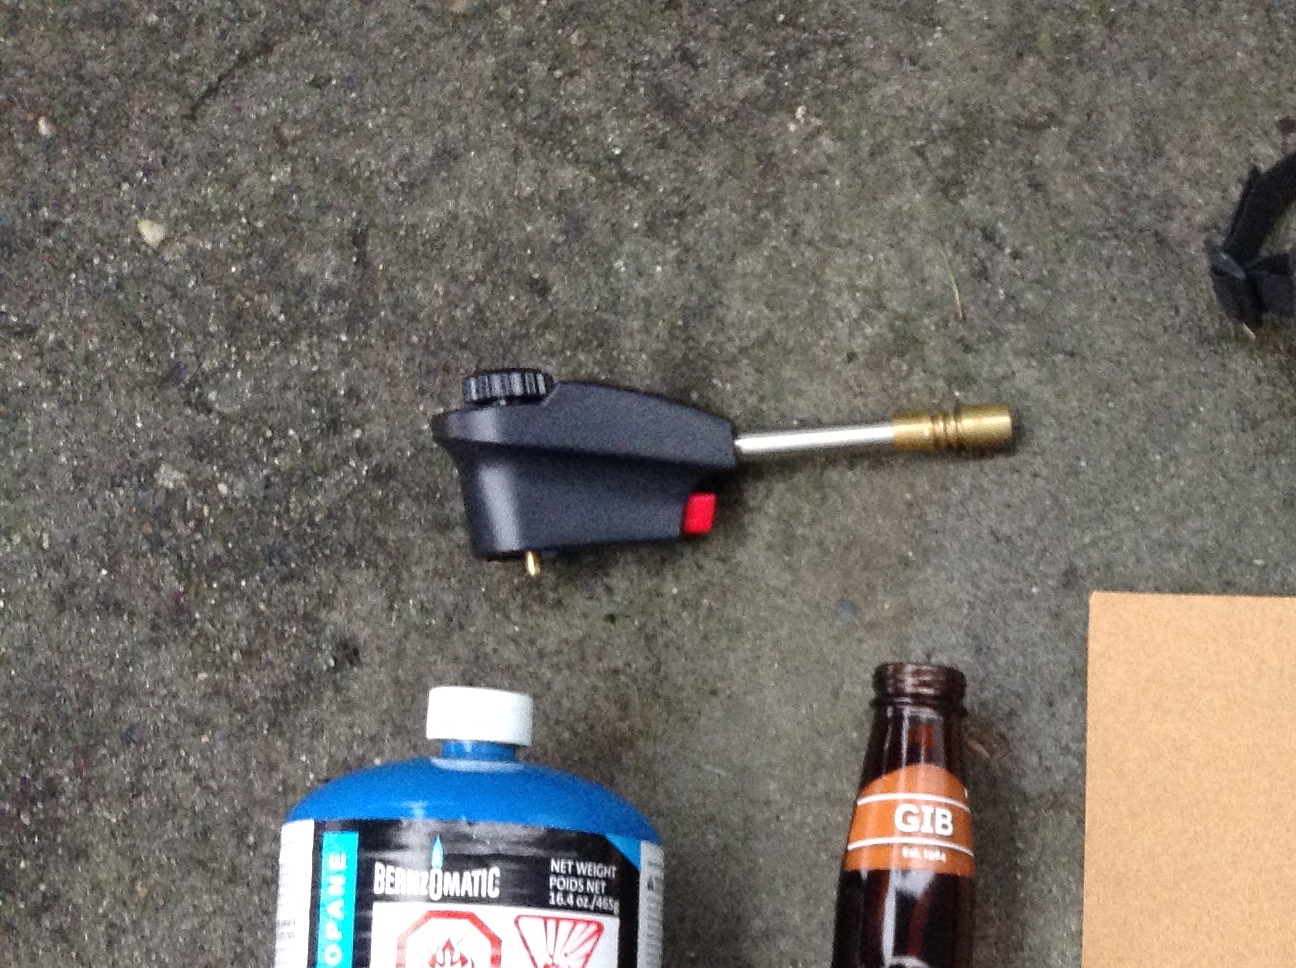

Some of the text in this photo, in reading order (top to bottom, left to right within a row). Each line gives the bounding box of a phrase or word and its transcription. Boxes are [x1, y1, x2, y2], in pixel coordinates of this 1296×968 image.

[893, 803, 954, 836] GIB
[550, 858, 617, 878] NET WEIGHT
[373, 861, 500, 900] BERNZOMATIC
[549, 874, 607, 894] POIDS NET
[549, 891, 574, 906] 16.4
